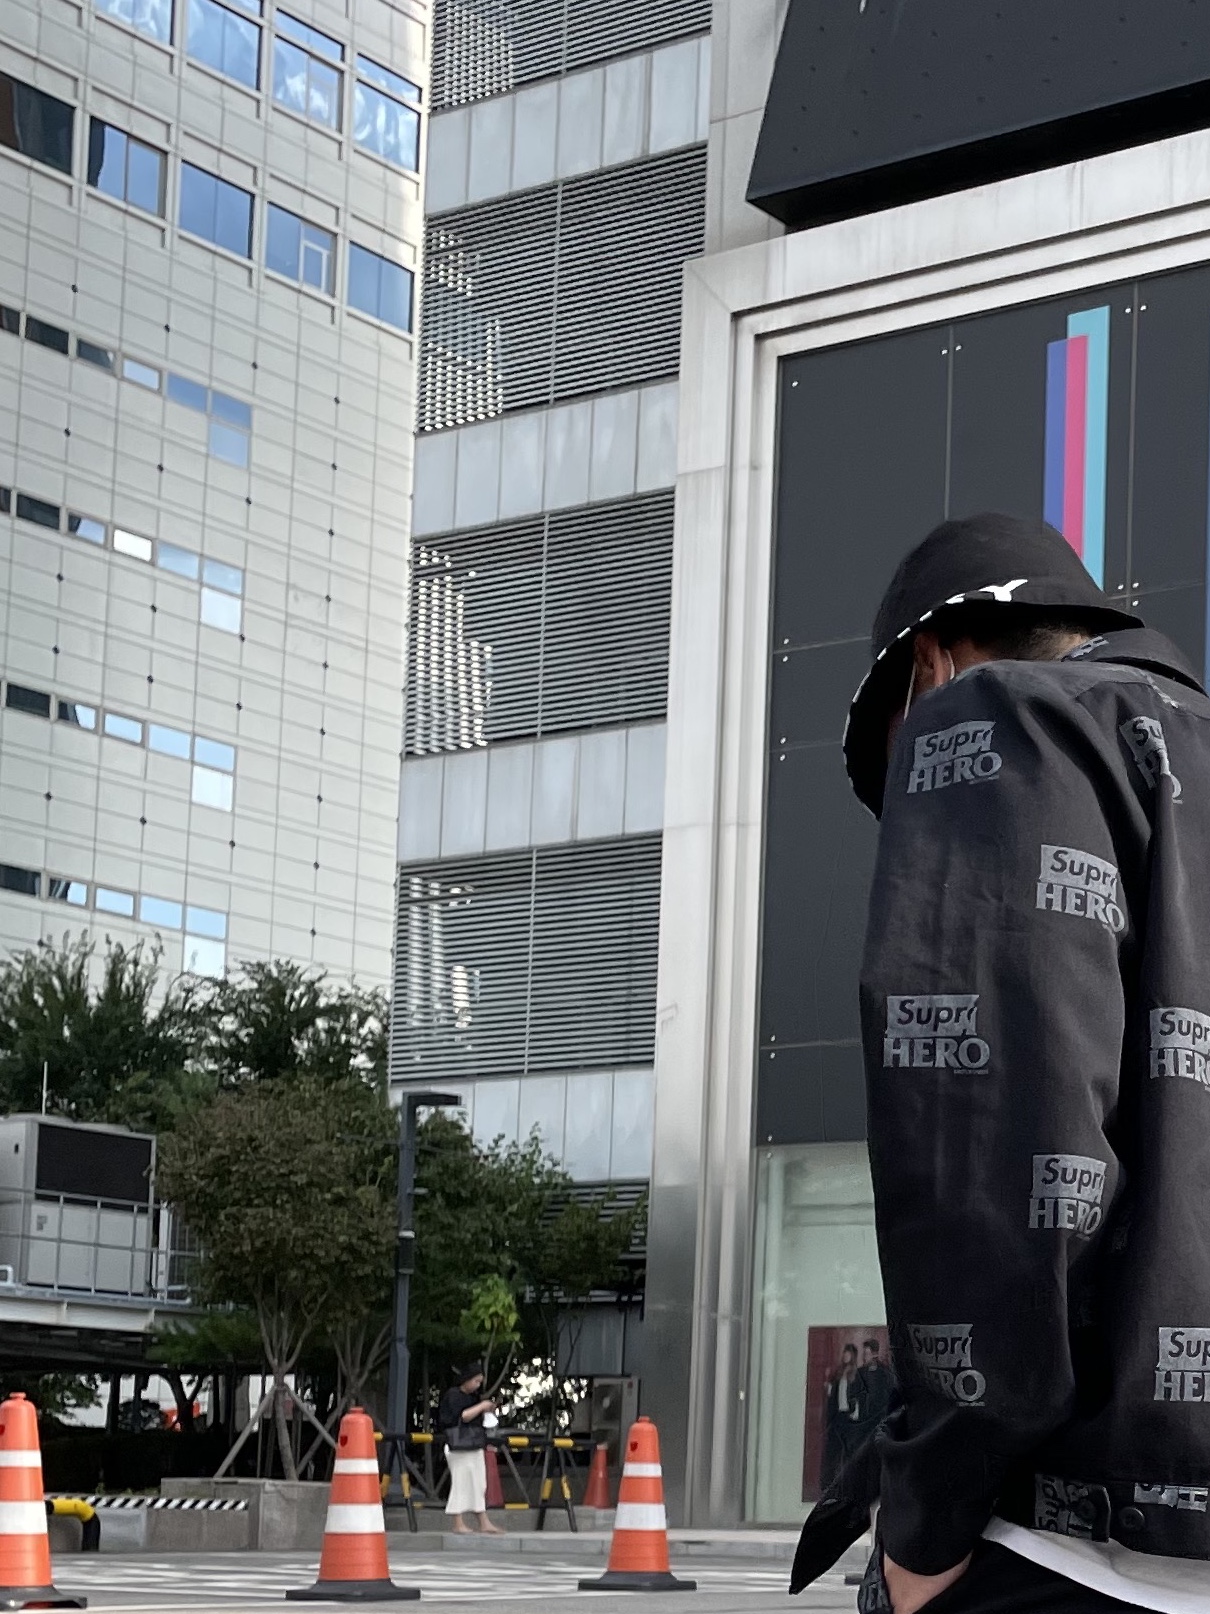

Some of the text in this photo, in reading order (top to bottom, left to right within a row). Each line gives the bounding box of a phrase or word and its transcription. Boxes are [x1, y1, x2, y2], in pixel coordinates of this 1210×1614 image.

[907, 751, 1002, 793] HERO
[1036, 882, 1125, 932] HERO
[883, 1037, 990, 1069] HERO
[1029, 1198, 1101, 1235] HERO
